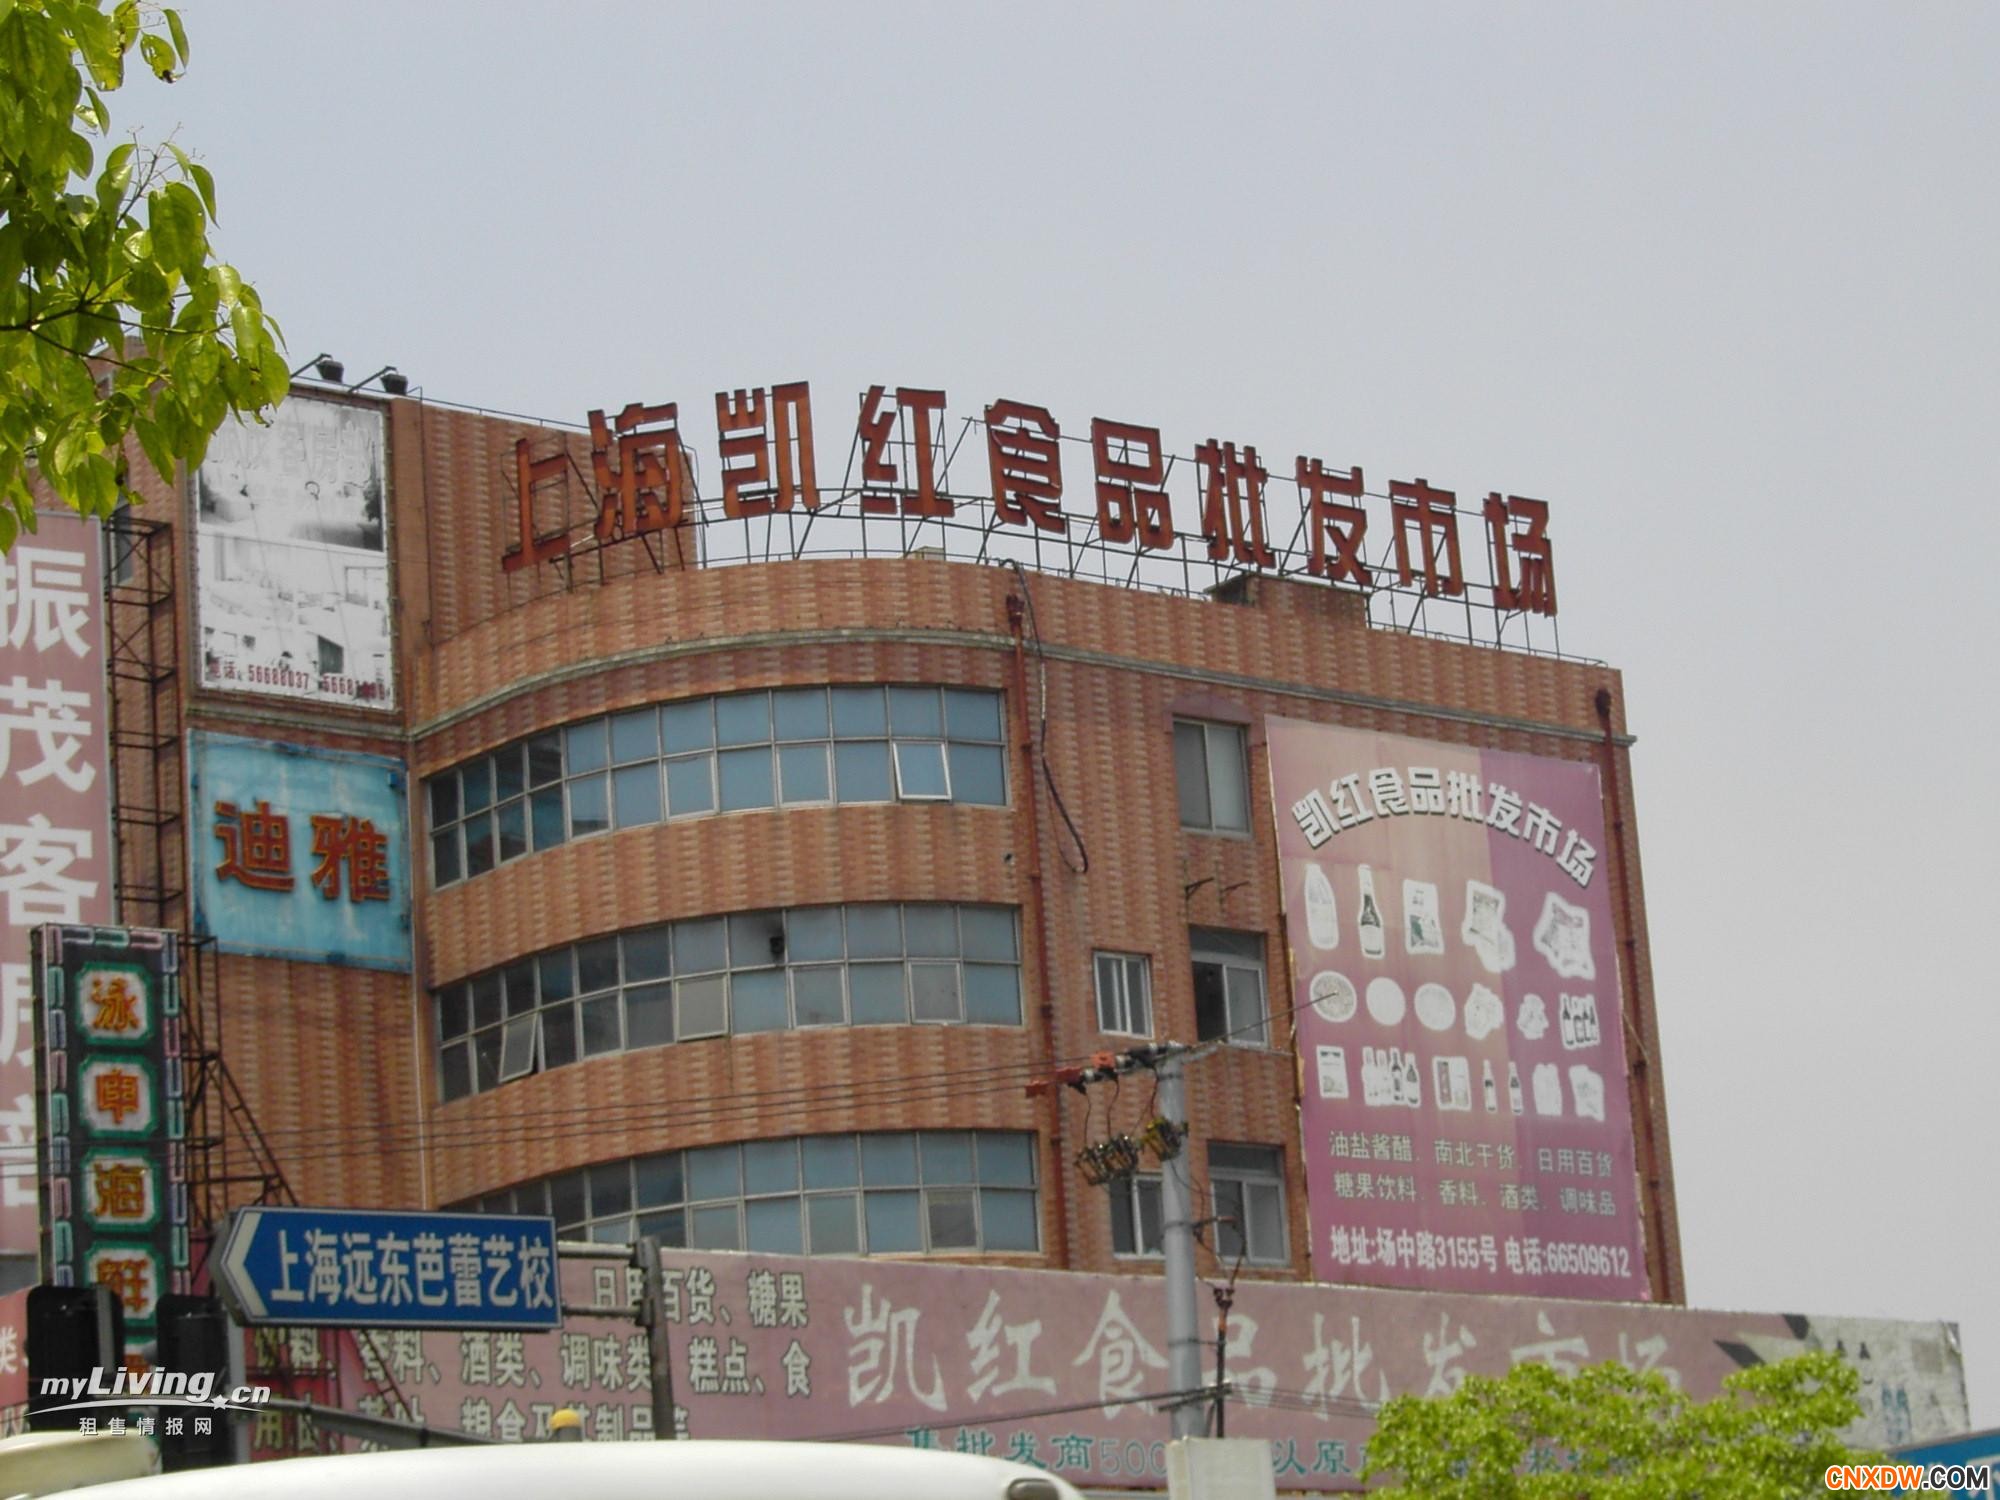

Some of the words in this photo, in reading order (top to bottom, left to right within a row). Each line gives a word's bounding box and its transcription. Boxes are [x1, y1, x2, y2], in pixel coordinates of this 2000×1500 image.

[502, 381, 1557, 616] 上海凯红食品批发市场
[213, 800, 391, 902] 迪雅
[1291, 766, 1597, 887] 凯红食品批发市场
[271, 1228, 552, 1308] 上海远东芭蕾艺校
